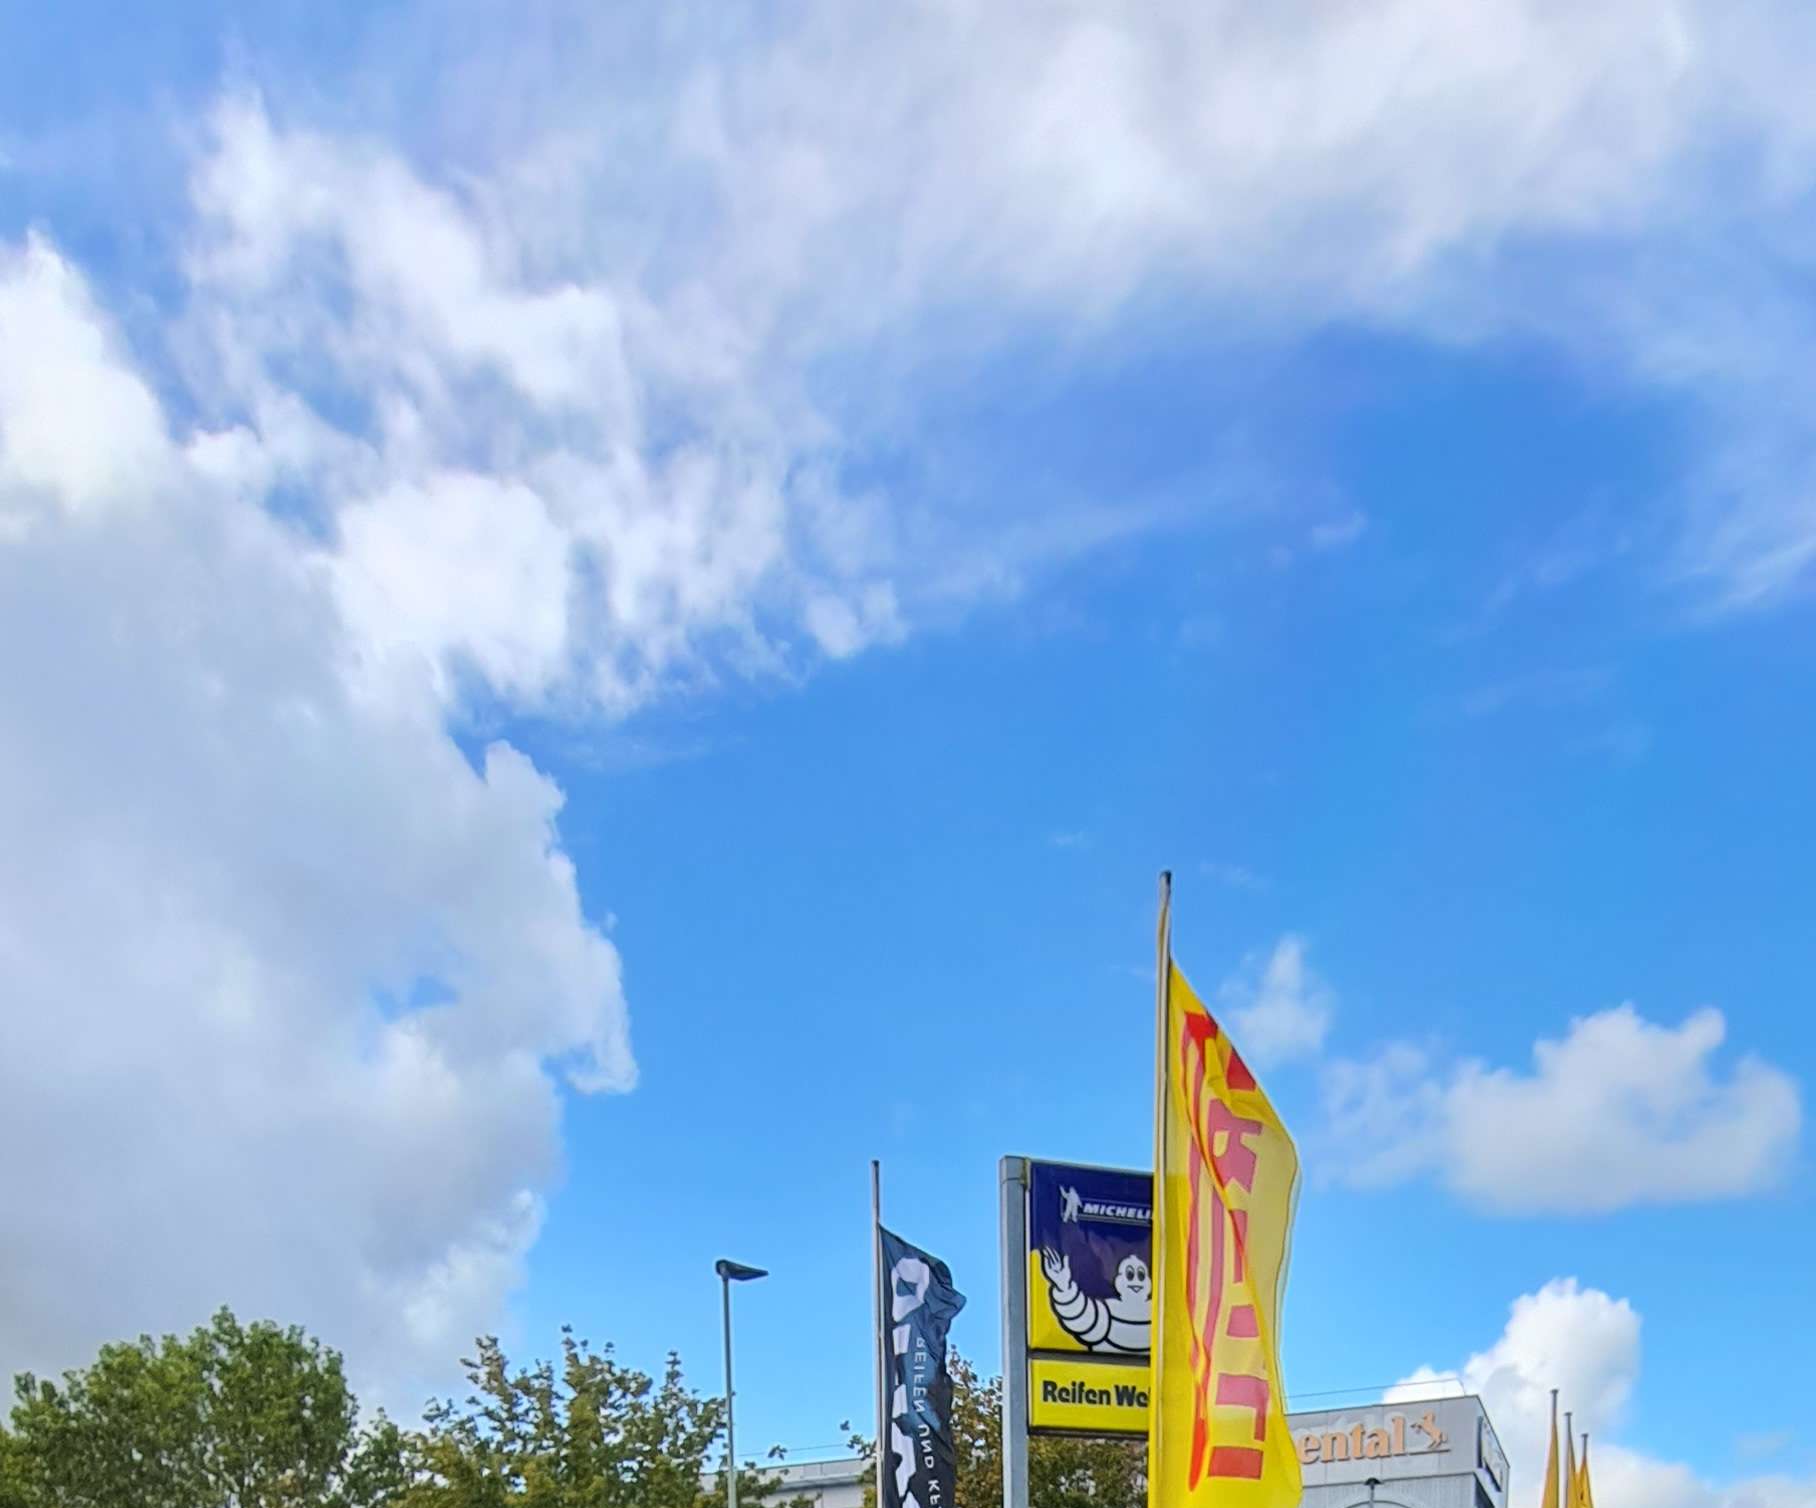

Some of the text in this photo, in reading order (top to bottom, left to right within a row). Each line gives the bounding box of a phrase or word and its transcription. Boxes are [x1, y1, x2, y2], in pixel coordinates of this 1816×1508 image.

[1083, 1202, 1151, 1220] MICHELI
[1043, 1380, 1151, 1408] Reifen We
[1297, 1415, 1406, 1465] ental
